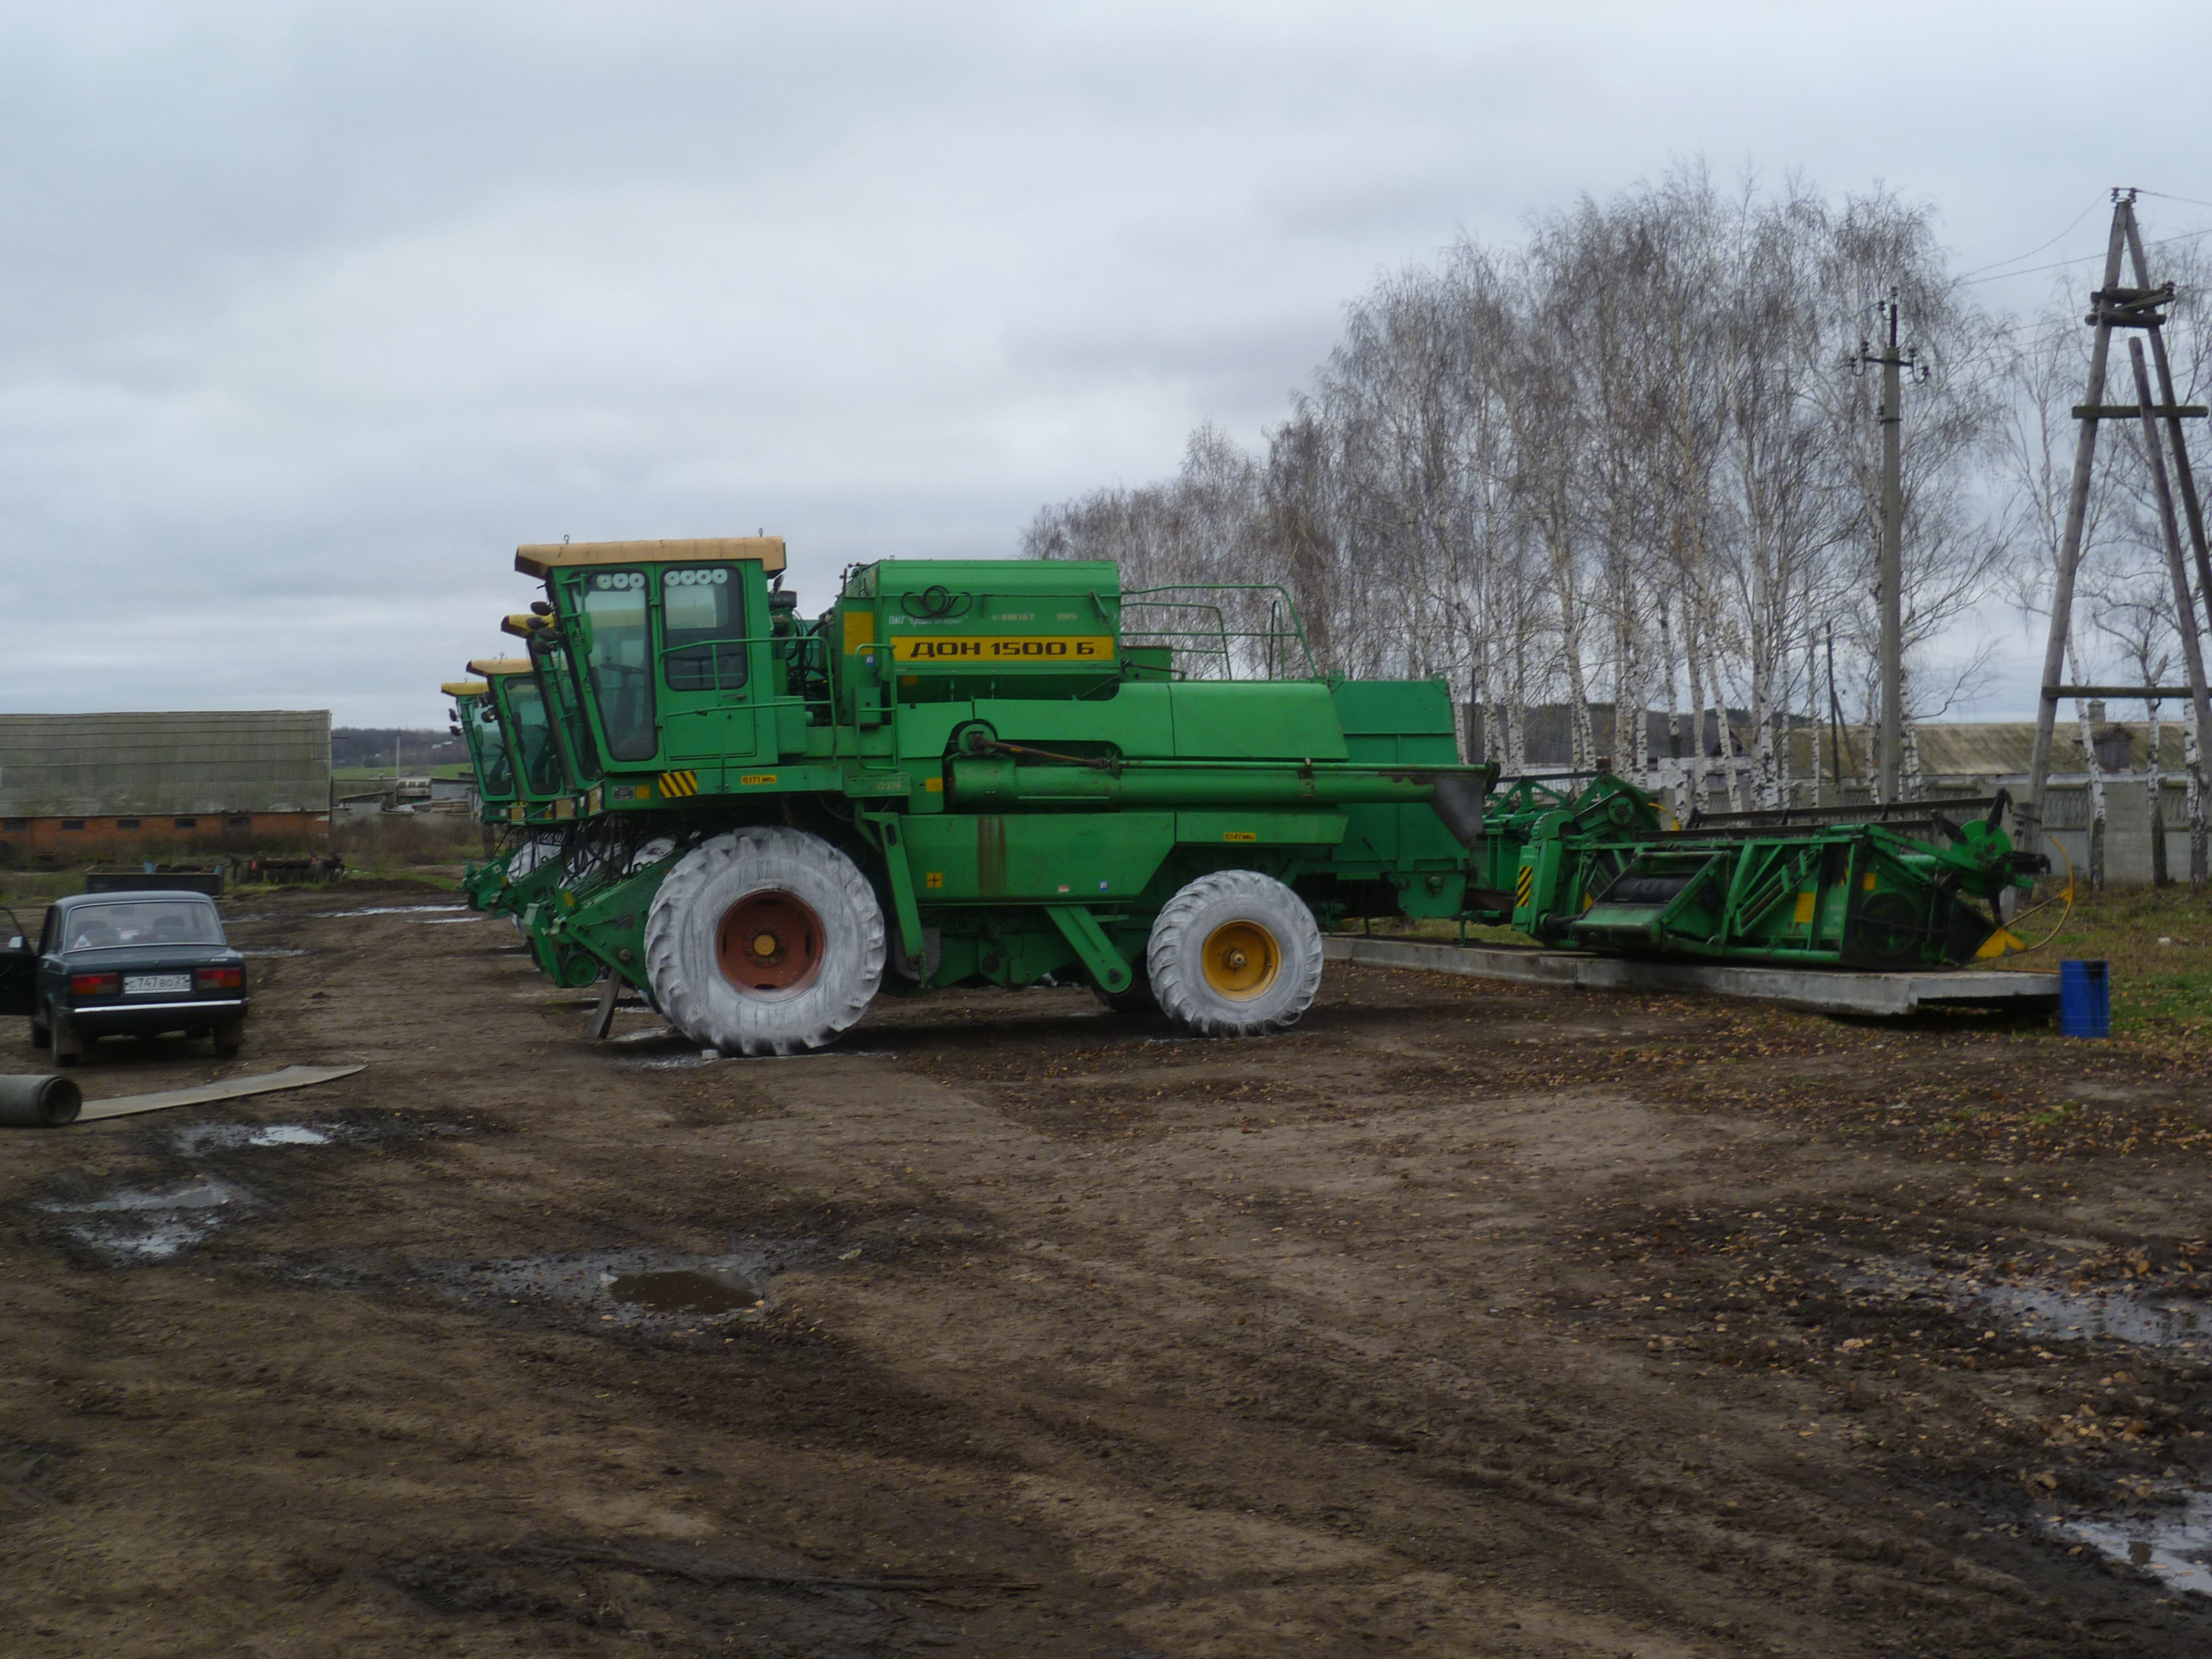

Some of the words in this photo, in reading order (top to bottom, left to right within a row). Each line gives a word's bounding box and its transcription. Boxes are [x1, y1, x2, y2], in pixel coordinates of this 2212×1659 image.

[910, 642, 980, 657] ДОН
[990, 642, 1066, 655] 1500
[1077, 642, 1094, 655] Б
